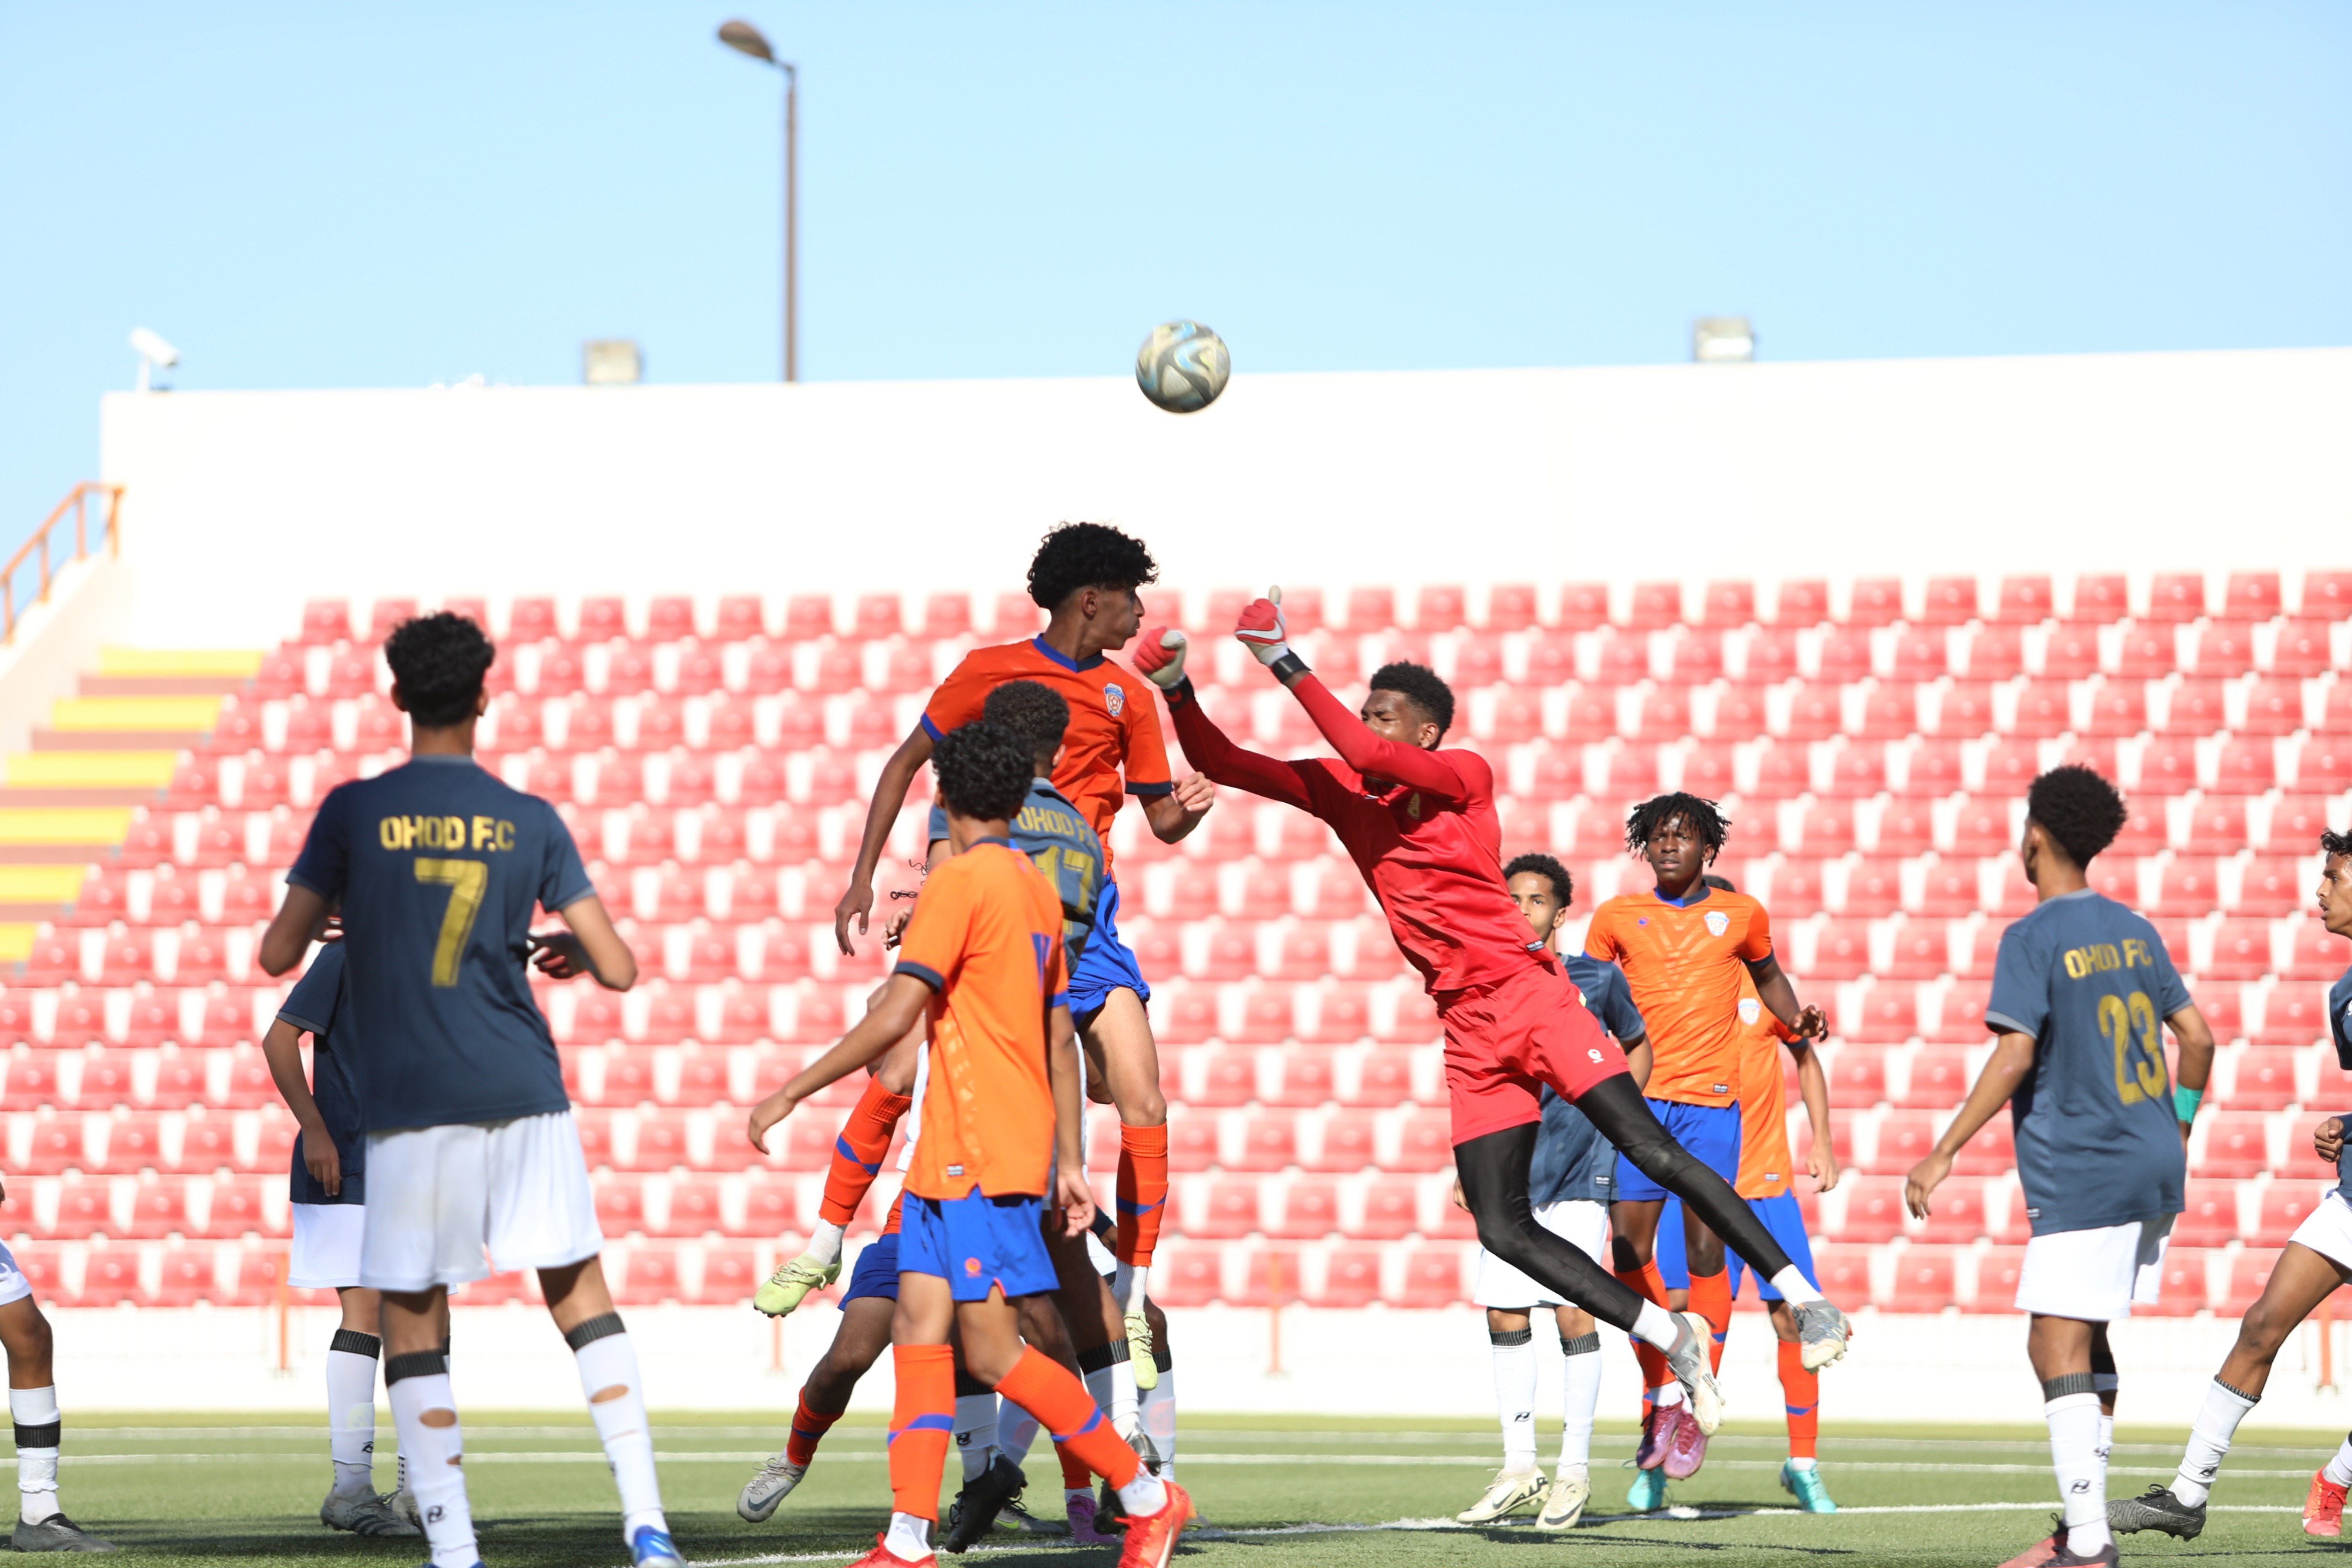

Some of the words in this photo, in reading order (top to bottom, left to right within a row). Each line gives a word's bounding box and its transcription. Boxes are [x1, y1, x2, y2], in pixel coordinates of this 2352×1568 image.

[379, 814, 466, 851] OHOD
[471, 815, 516, 852] F.C
[1016, 807, 1075, 836] OHOD
[414, 856, 489, 988] 7
[2064, 943, 2121, 979] OHOD
[2097, 990, 2168, 1107] 23
